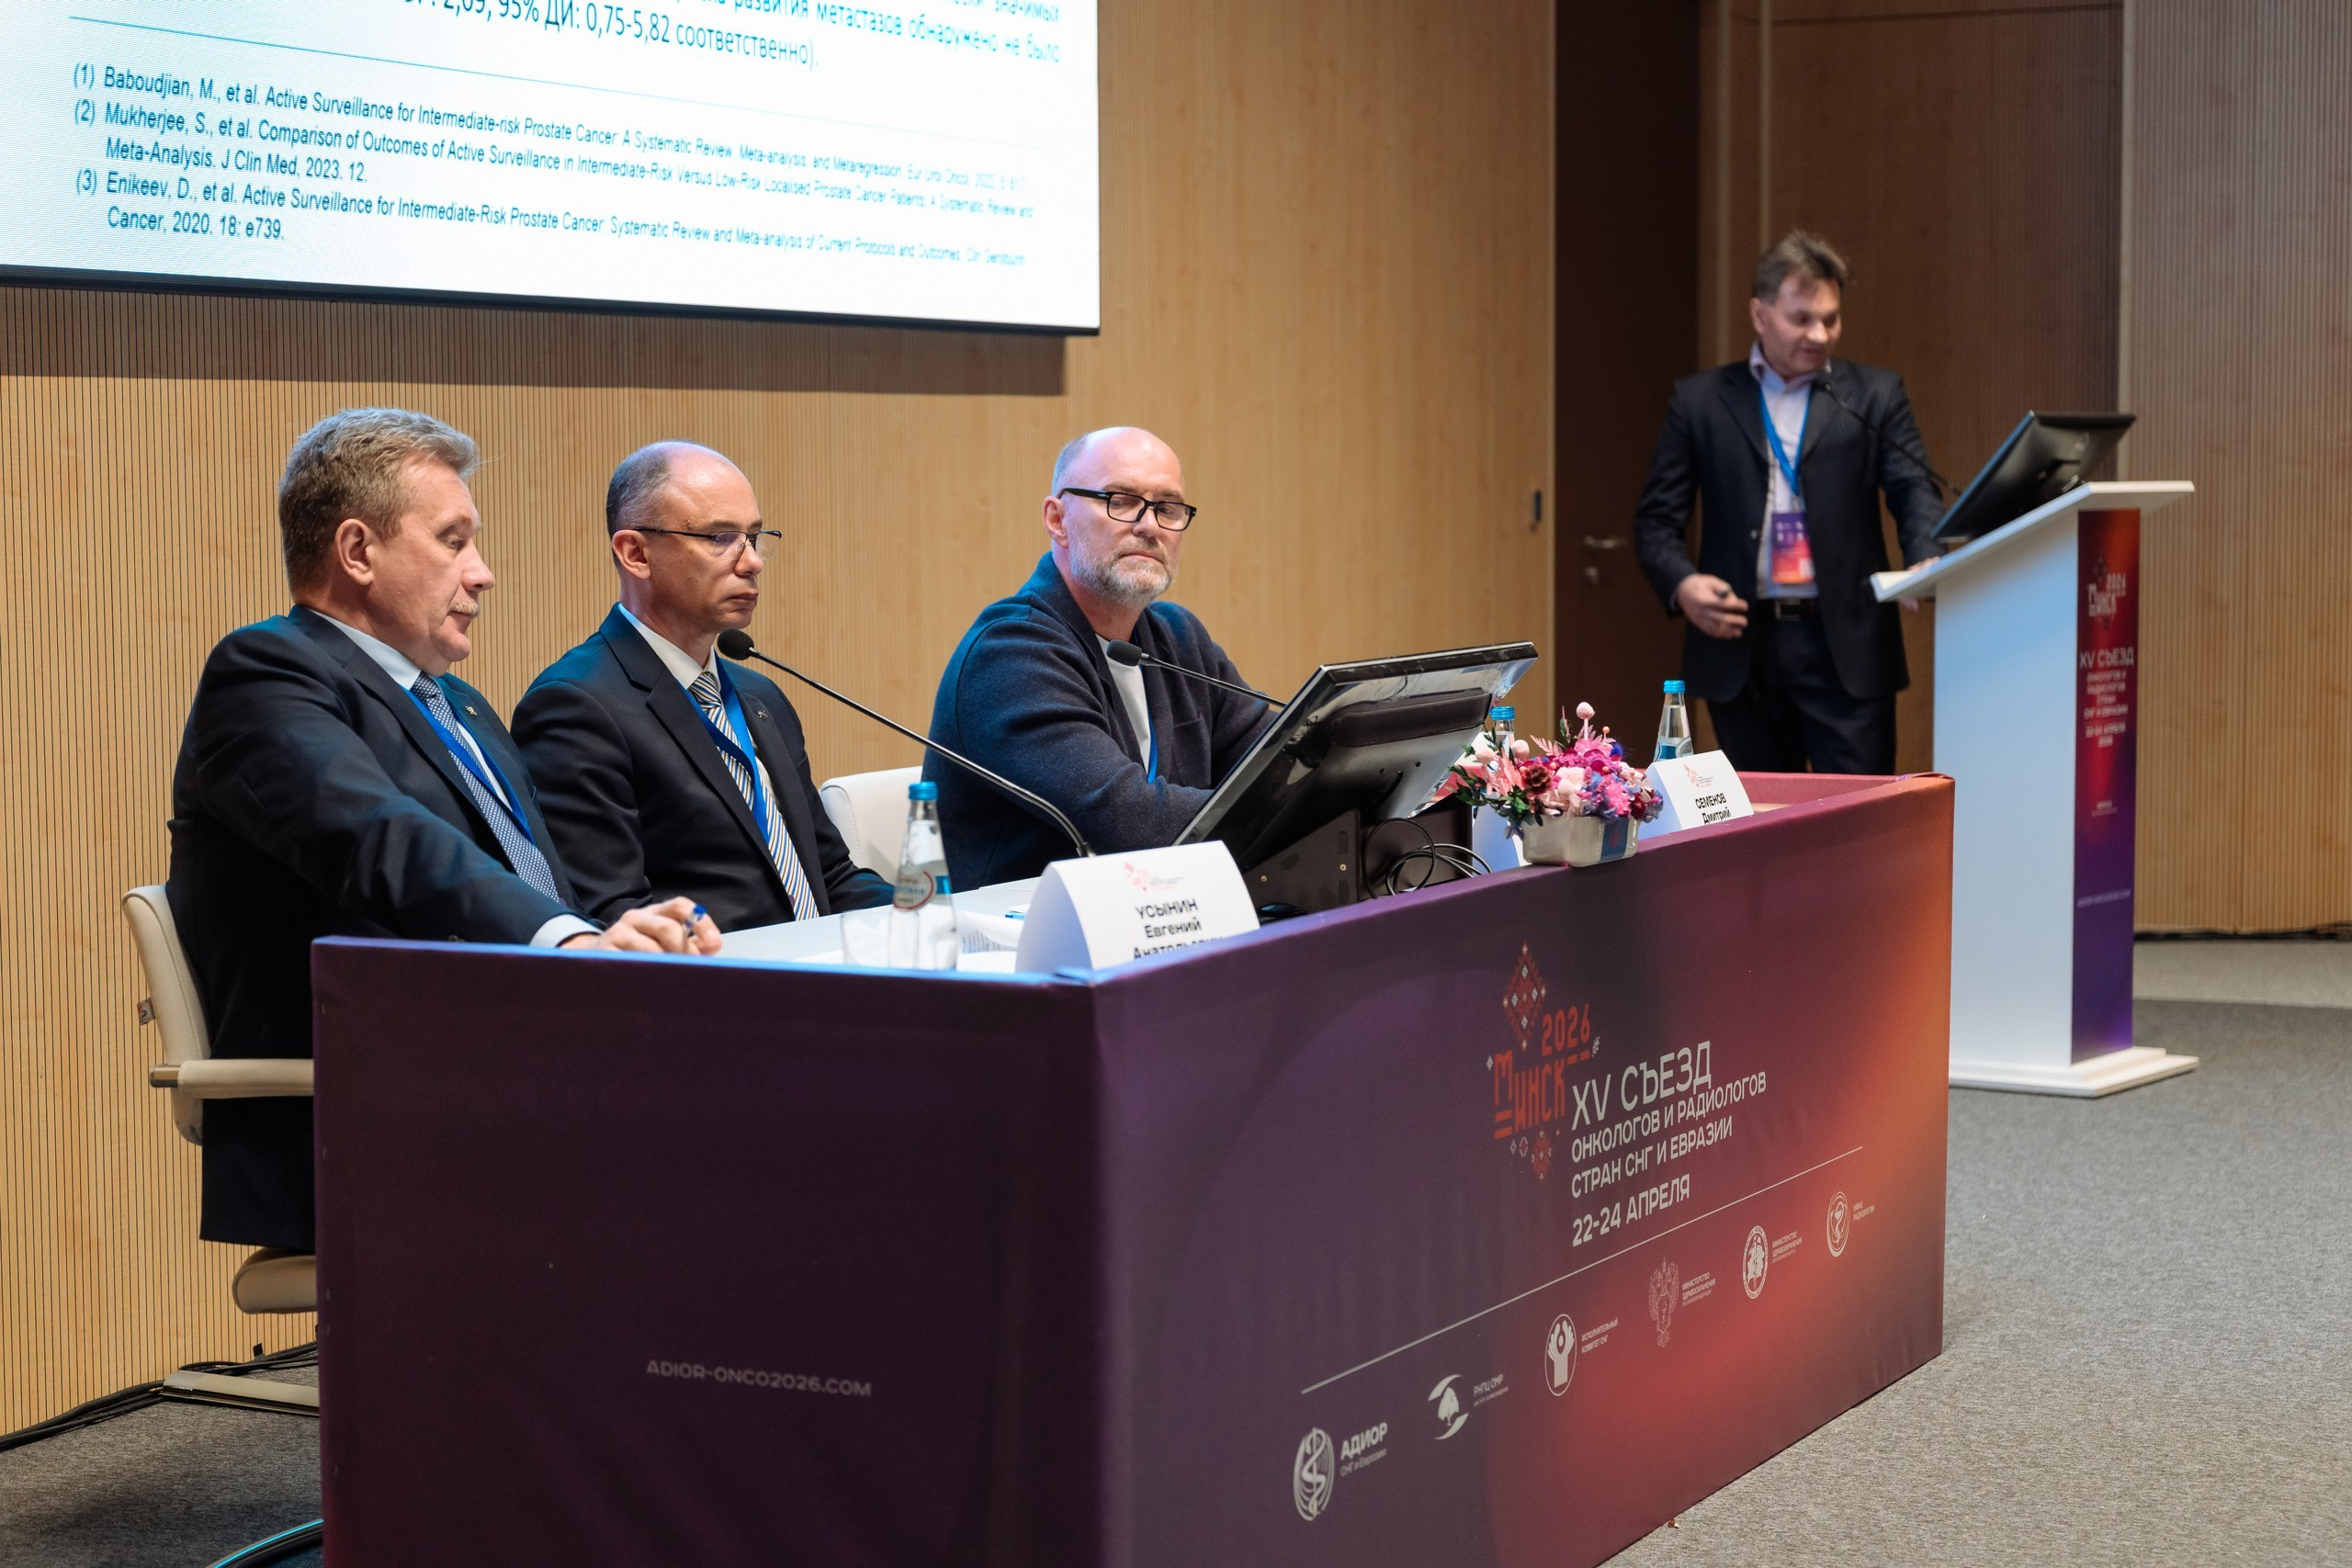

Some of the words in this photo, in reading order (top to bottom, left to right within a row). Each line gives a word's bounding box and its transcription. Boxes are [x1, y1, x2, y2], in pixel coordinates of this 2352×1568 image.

[545, 0, 580, 32] ДИ:
[586, 3, 670, 45] 0,75-5,82
[676, 24, 819, 72] соответственно).
[815, 3, 902, 37] метастазов
[74, 62, 95, 90] (1)
[104, 66, 193, 100] Baboudjian,
[199, 78, 220, 103] M.,
[226, 85, 240, 102] et
[244, 85, 260, 105] al.
[266, 86, 308, 110] Active
[312, 91, 393, 119] Surveillance
[398, 102, 415, 122] for
[419, 105, 521, 134] Intermediate-risk
[525, 118, 571, 141] Prostate
[622, 129, 630, 147] A
[634, 130, 692, 154] Systematic
[813, 154, 830, 172] and
[74, 99, 96, 127] (2)
[106, 102, 188, 135] Mukherjee,
[195, 112, 213, 137] S.,
[219, 118, 232, 137] et
[237, 119, 253, 139] al.
[258, 119, 342, 149] Comparison
[346, 130, 359, 149] of
[363, 131, 428, 156] Outcomes
[433, 140, 445, 158] of
[447, 140, 484, 163] Active
[489, 145, 560, 170] Surveillance
[564, 153, 573, 171] in
[578, 154, 673, 182] Intermediate-Risk
[677, 164, 712, 186] Versus
[715, 169, 761, 192] Low-Risk
[764, 174, 810, 196] Localised
[814, 179, 852, 200] Prostate
[106, 137, 216, 171] Meta-Analysis.
[221, 150, 230, 169] J
[234, 150, 261, 173] Clin
[306, 157, 343, 180] 2023.
[349, 162, 368, 182] 12.
[76, 168, 97, 196] (3)
[107, 171, 171, 200] Enikeev,
[177, 177, 197, 201] D.,
[203, 184, 217, 201] et
[221, 184, 237, 203] al.
[243, 184, 285, 207] Active
[291, 188, 372, 214] Surveillance
[378, 196, 394, 216] for
[399, 197, 506, 226] Intermediate-Risk
[510, 208, 559, 229] Prostate
[610, 214, 669, 238] Systematic
[672, 220, 710, 241] Review
[713, 227, 732, 243] and
[735, 227, 802, 250] Meta-analysis
[806, 231, 815, 250] of
[107, 206, 166, 234] Cancer,
[173, 211, 213, 235] 2020.
[220, 215, 240, 237] 18:
[245, 217, 285, 241] e739.
[2098, 647, 2134, 669] СЪЕЗД
[1695, 793, 1726, 809] СЕМЕНОВ
[1702, 807, 1732, 825] Дмитрий
[1135, 898, 1198, 919] УСЫНИН
[1144, 917, 1202, 938] Евгений
[1542, 1003, 1590, 1056] 2026
[1571, 1074, 1611, 1132] XV
[1621, 1040, 1712, 1111] СЪЕЗД
[1571, 1110, 1660, 1163] ОНКОЛОГОВ
[1664, 1104, 1673, 1129] И
[1678, 1071, 1767, 1123] РАДИОЛОГОВ
[1571, 1158, 1621, 1199] СТРАН
[1625, 1145, 1653, 1177] СНГ
[1657, 1140, 1667, 1165] И
[1670, 1115, 1733, 1159] ЕВРАЗИИ
[1572, 1201, 1622, 1247] 22-24
[1625, 1173, 1690, 1225] АПРЕЛЯ
[647, 1359, 872, 1397] ADIOR-ONCO2026.COM
[1340, 1422, 1387, 1461] АДИОР
